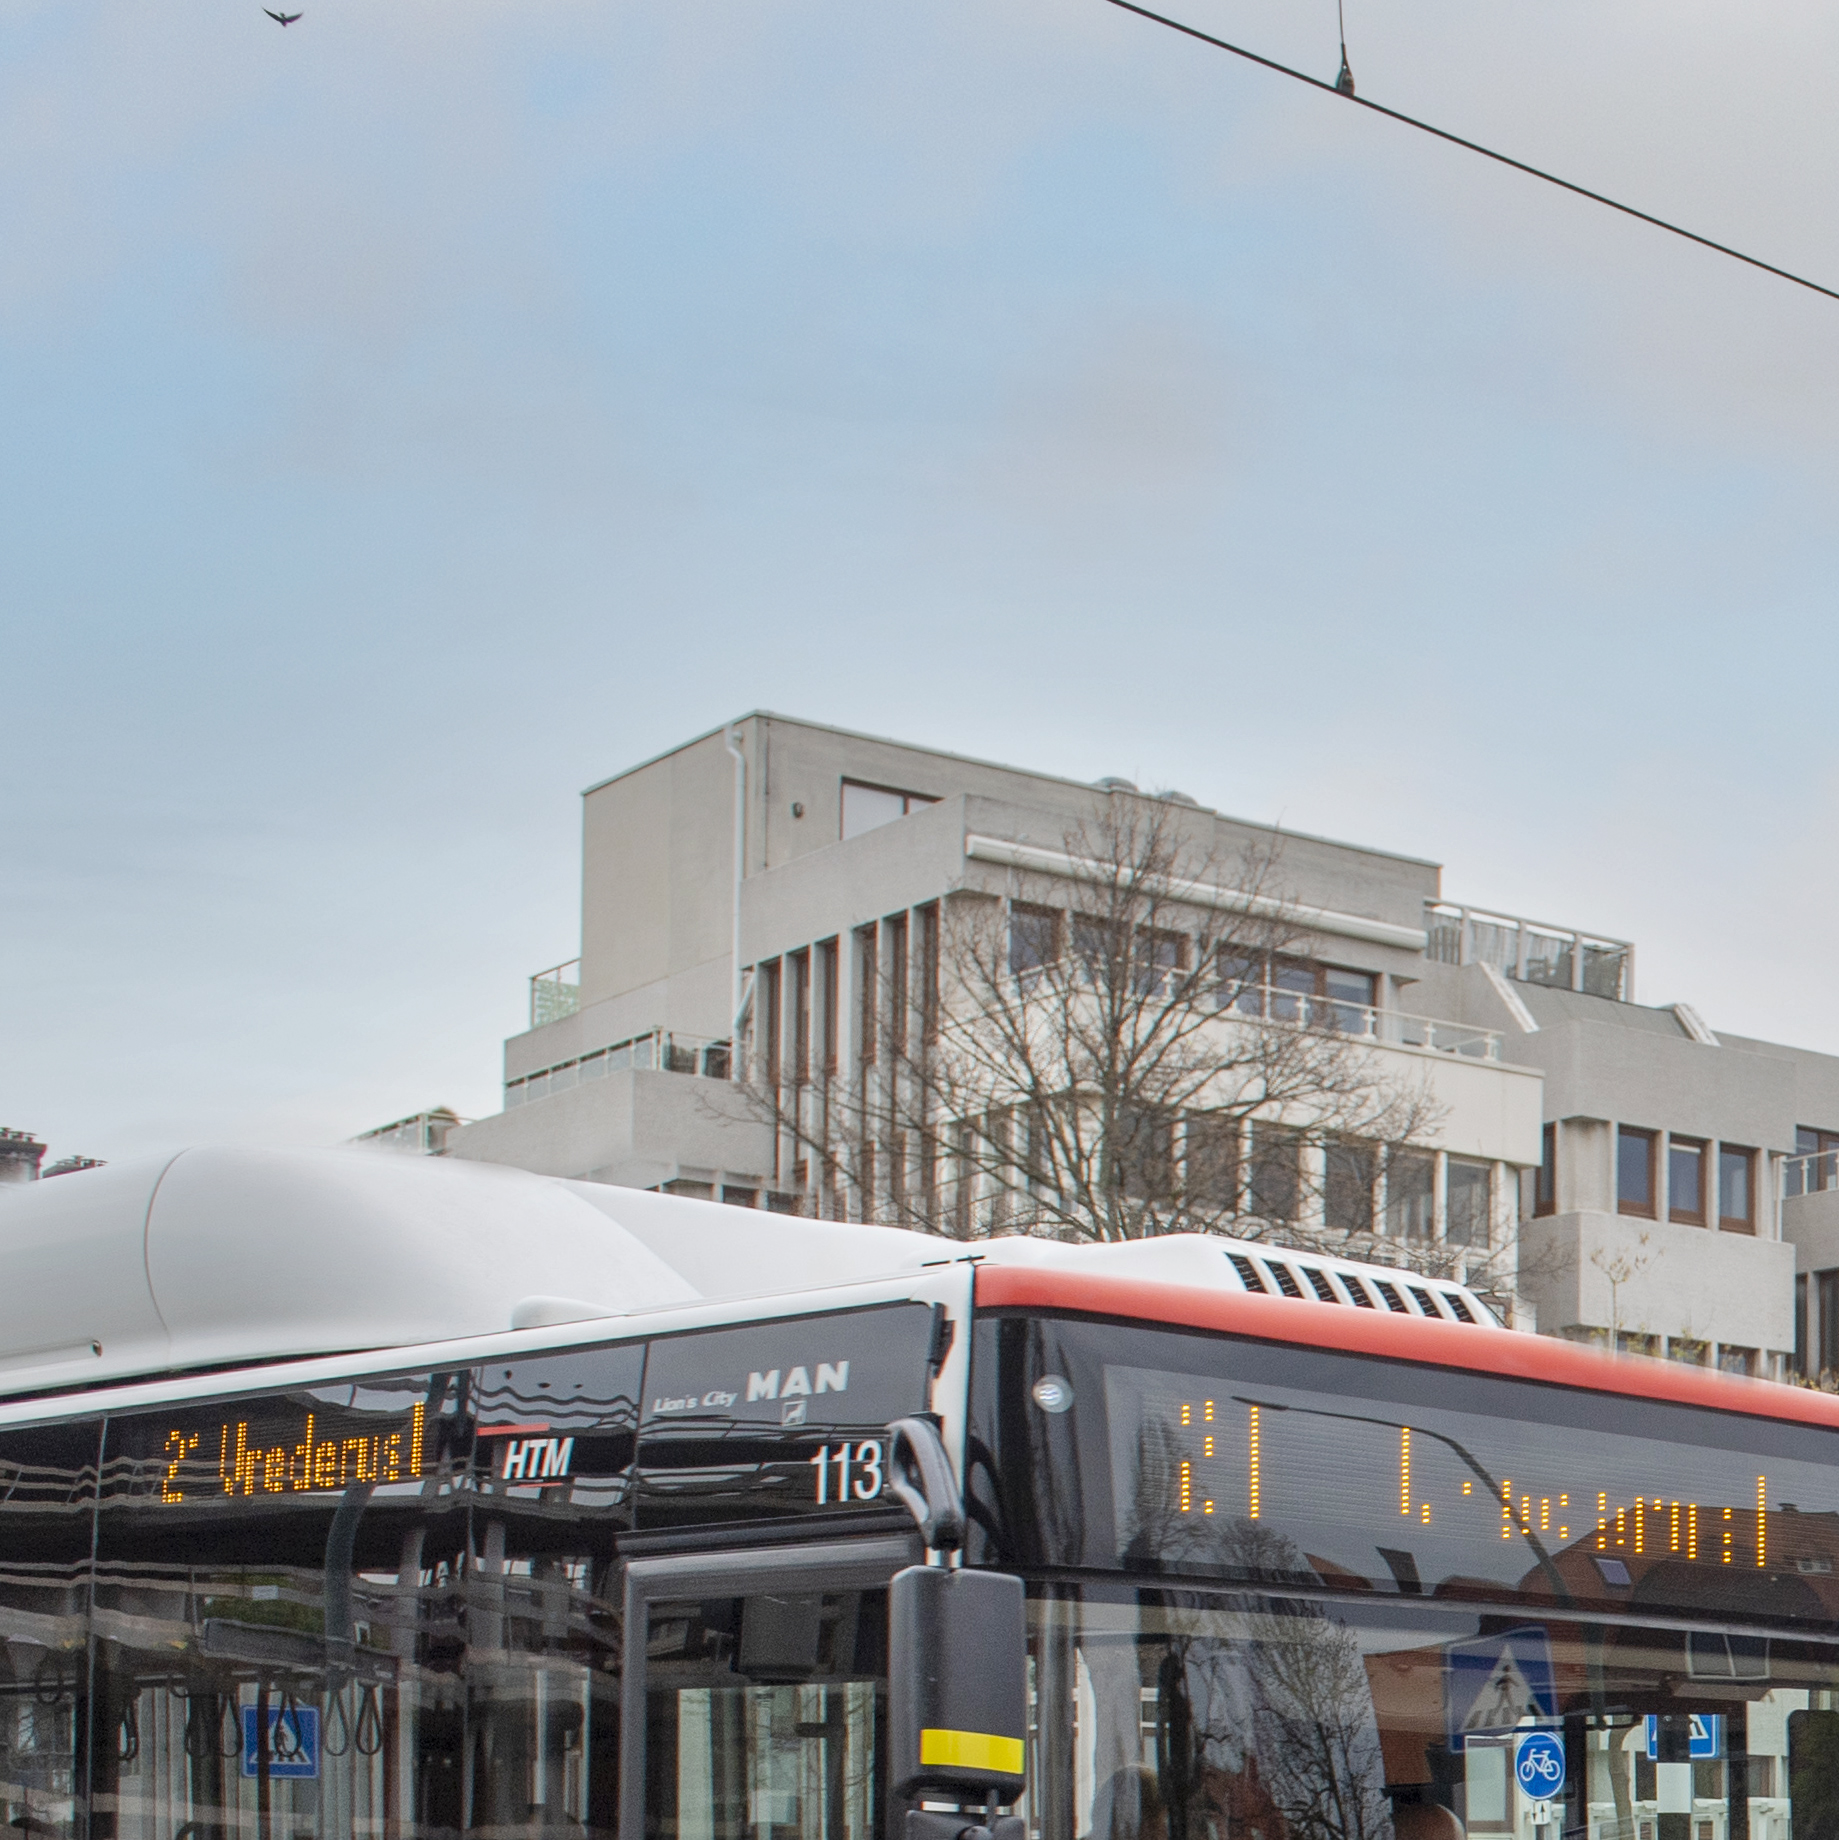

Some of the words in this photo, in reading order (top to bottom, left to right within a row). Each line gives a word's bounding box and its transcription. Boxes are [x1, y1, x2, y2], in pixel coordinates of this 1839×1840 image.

[652, 1394, 698, 1414] Lion's
[701, 1390, 738, 1409] City
[746, 1360, 850, 1402] MAN
[502, 1437, 574, 1480] HTM
[810, 1439, 889, 1505] 113
